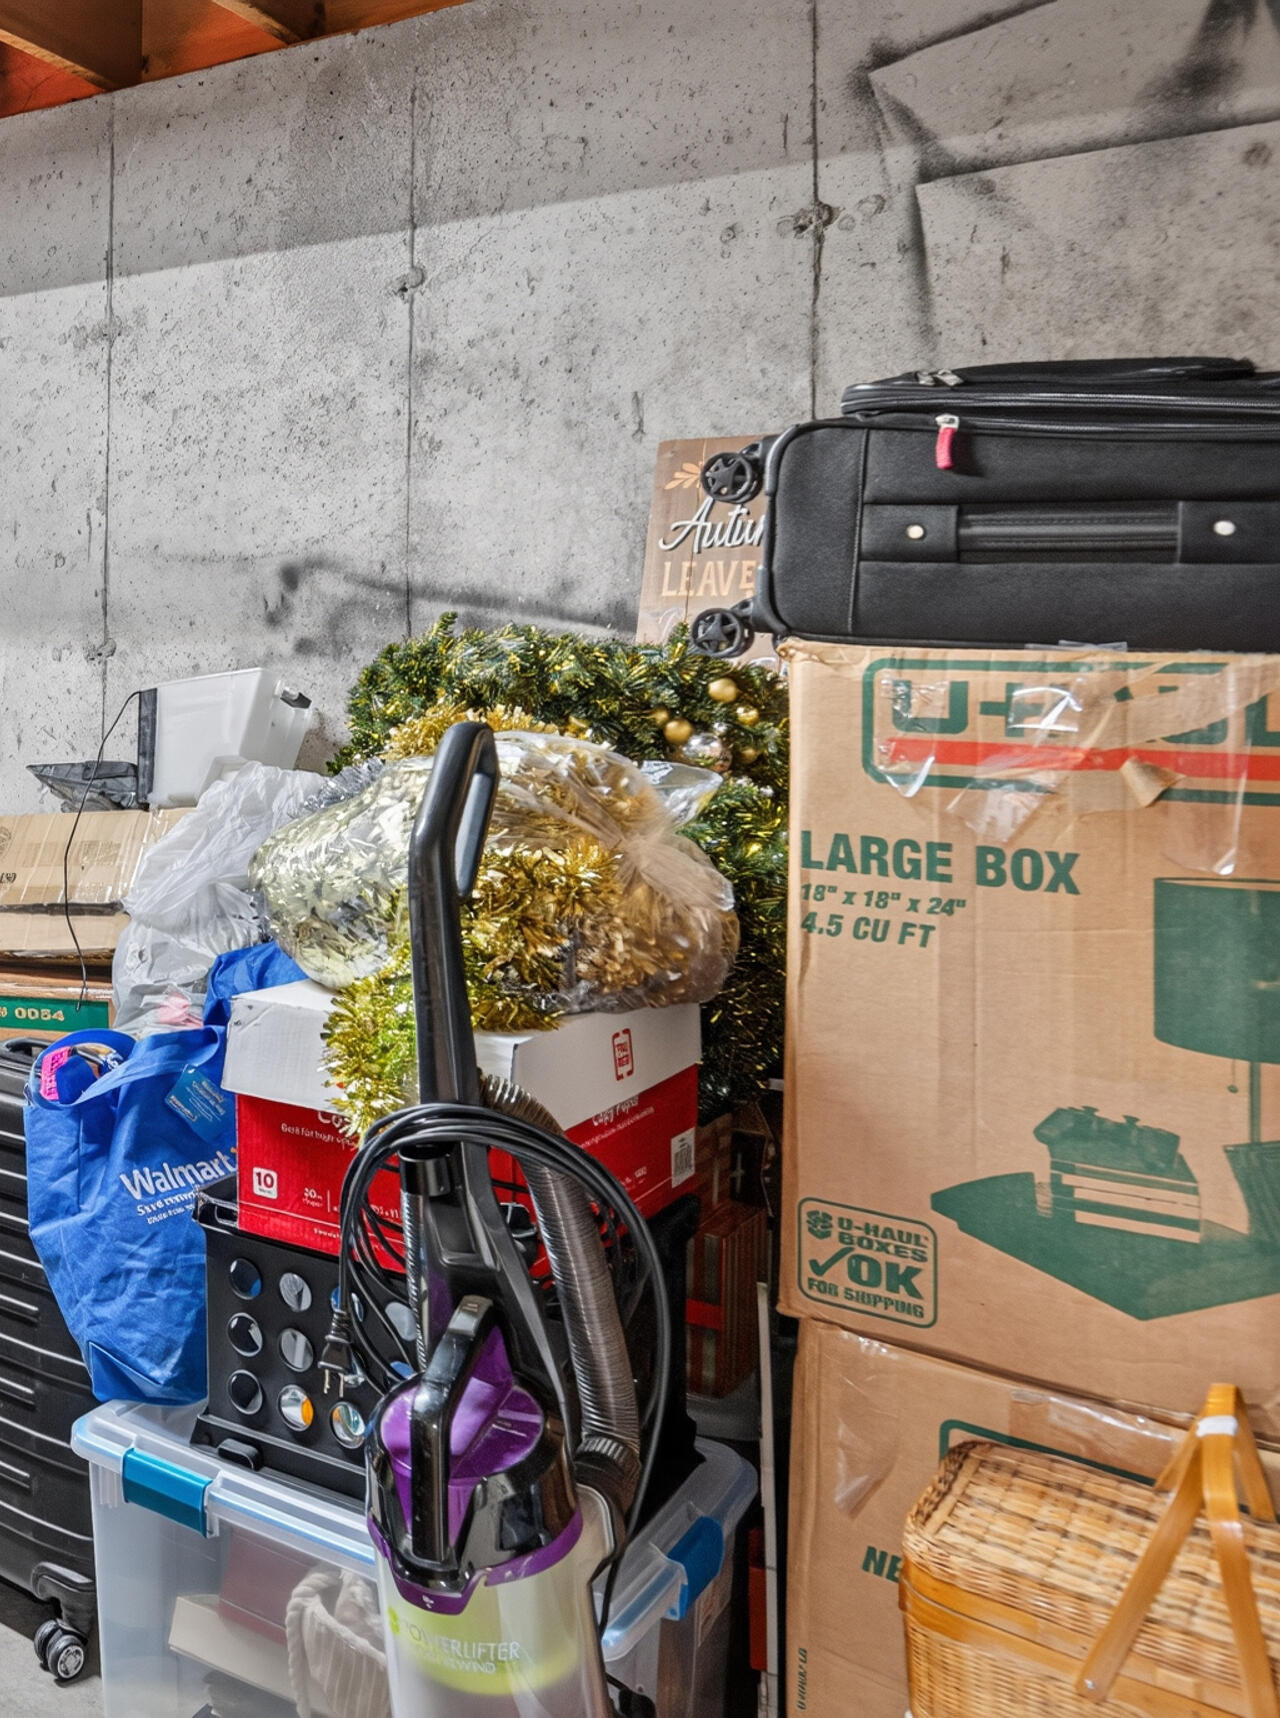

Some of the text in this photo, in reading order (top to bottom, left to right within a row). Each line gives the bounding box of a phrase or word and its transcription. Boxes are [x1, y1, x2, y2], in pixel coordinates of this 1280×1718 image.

[801, 830, 1080, 895] LARGE BOX
[801, 883, 837, 902] 18"
[863, 889, 901, 909] 18"
[926, 897, 966, 917] 24"
[801, 911, 936, 948] 4.5 CU FT
[14, 1007, 65, 1021] 0054
[120, 1150, 237, 1200] Walmart
[255, 1171, 274, 1188] 10
[838, 1216, 929, 1249] U-HAUL
[838, 1231, 929, 1263] BOXES
[807, 1276, 839, 1297] FOR
[847, 1253, 924, 1300] OK
[843, 1286, 925, 1319] SHIPPING
